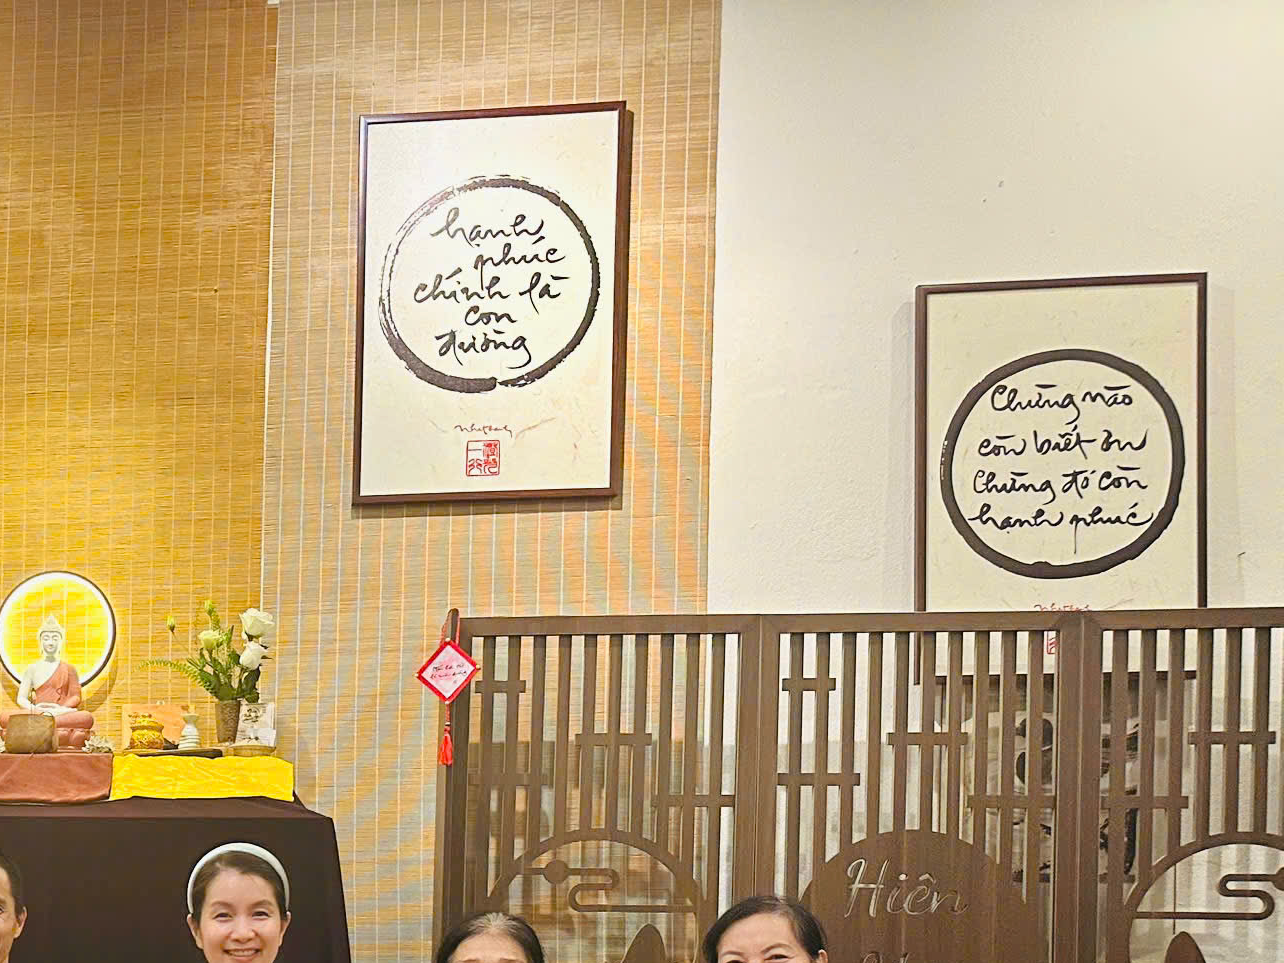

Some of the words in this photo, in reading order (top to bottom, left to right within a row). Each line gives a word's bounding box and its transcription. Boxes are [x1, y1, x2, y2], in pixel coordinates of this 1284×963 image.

[430, 207, 544, 248] hạnh
[474, 236, 566, 291] phúc
[414, 267, 510, 303] chính
[519, 272, 570, 314] là
[465, 305, 517, 326] con
[435, 329, 532, 369] đường
[991, 384, 1080, 425] Chừng
[1082, 385, 1133, 407] nào
[1033, 425, 1097, 460] biết
[1062, 470, 1096, 499] đó
[968, 503, 1064, 534] hạnh
[1070, 502, 1154, 554] phúc
[844, 857, 968, 918] Hiên
